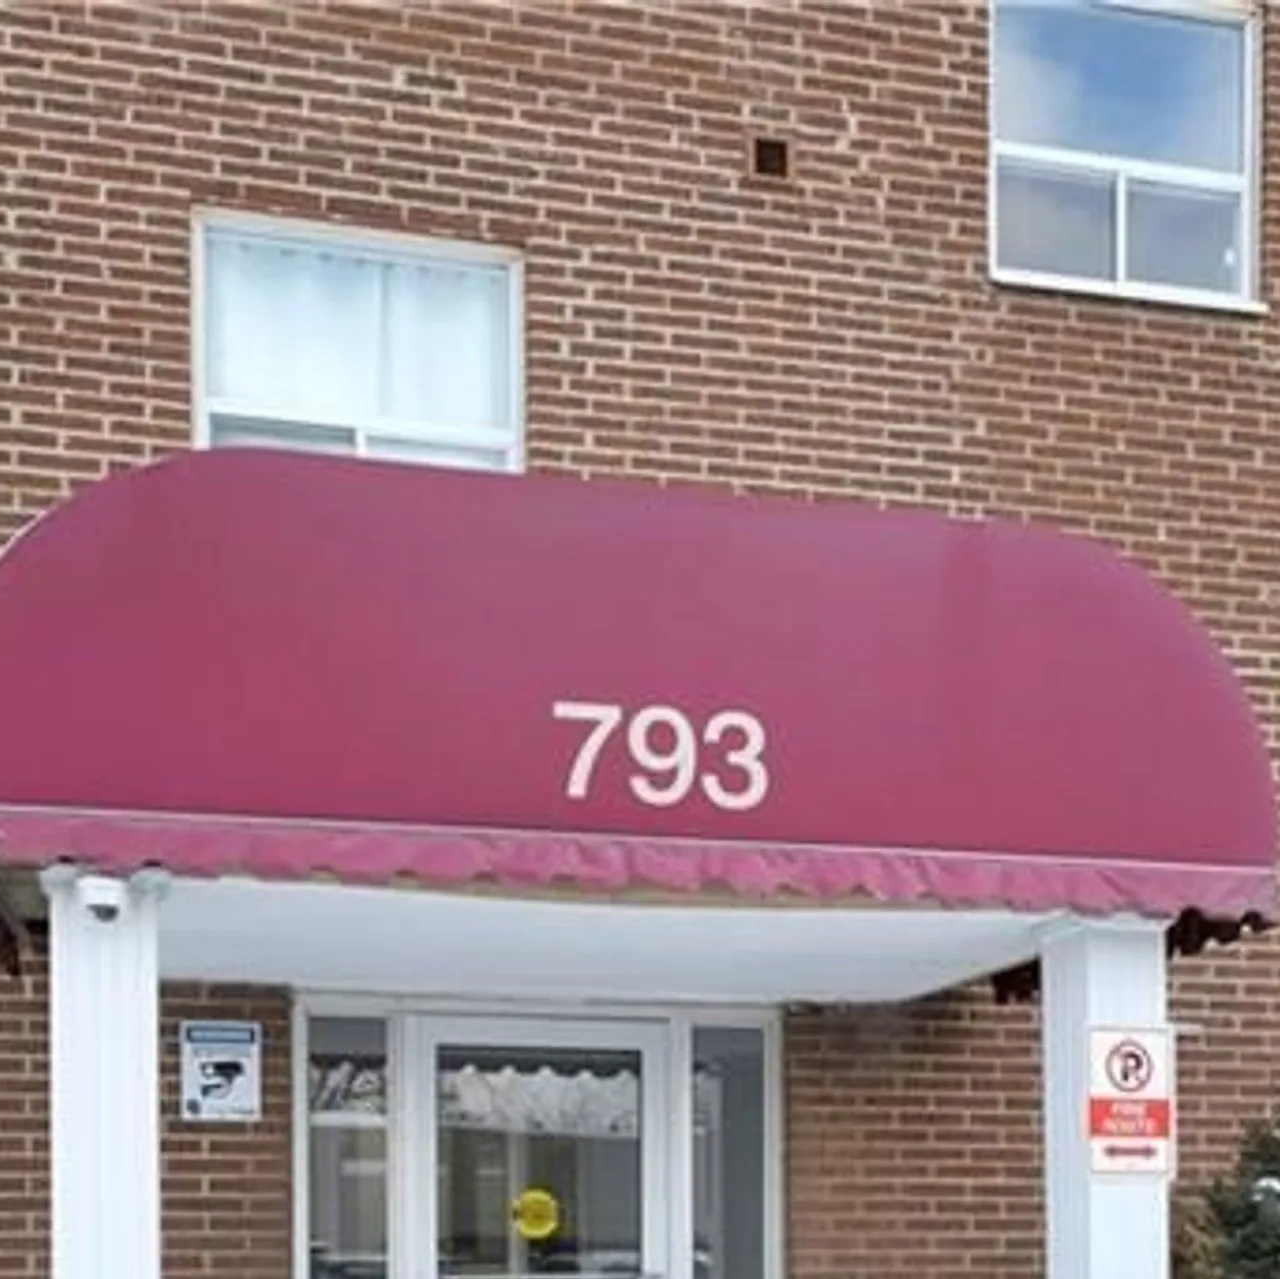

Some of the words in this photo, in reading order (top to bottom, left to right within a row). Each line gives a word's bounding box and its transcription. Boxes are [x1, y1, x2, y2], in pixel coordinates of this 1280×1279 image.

[552, 700, 769, 811] 793
[1110, 1101, 1147, 1116] FIRE
[1102, 1117, 1157, 1135] ROUTE
